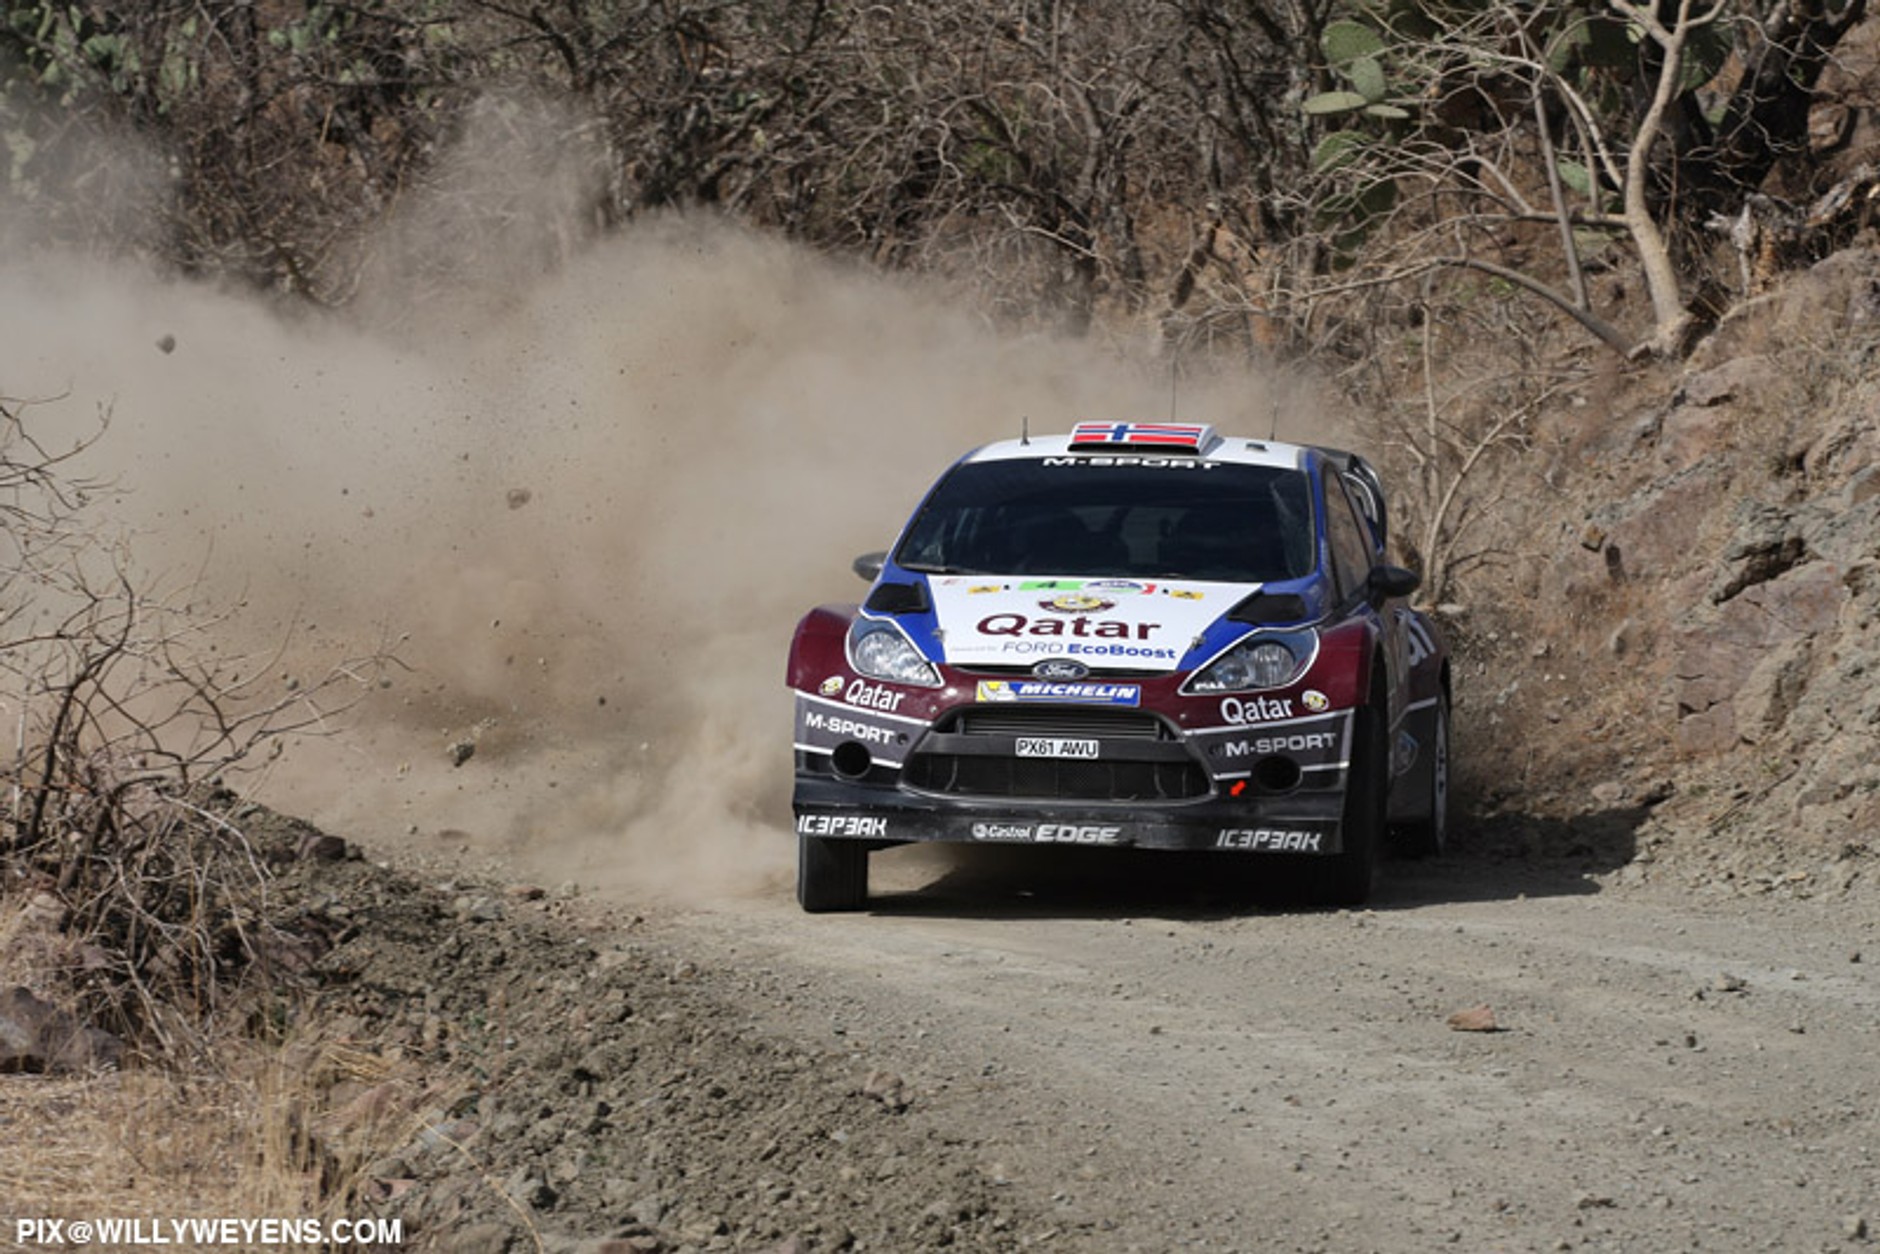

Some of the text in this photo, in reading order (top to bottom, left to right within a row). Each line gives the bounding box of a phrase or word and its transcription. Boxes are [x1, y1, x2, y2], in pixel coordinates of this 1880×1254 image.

[1043, 457, 1221, 469] M-SPORT
[976, 613, 1161, 640] Qatar
[1002, 641, 1063, 653] FORD
[1067, 643, 1176, 659] EcoBoost
[845, 679, 906, 711] Qatar
[1019, 683, 1137, 699] MICHELIN
[1220, 696, 1292, 725] Qatar
[805, 712, 896, 744] M-SPORT
[1016, 740, 1098, 757] PX61 AWU
[1225, 732, 1337, 758] M-SPORT
[988, 824, 1121, 843] Castrol EDGE
